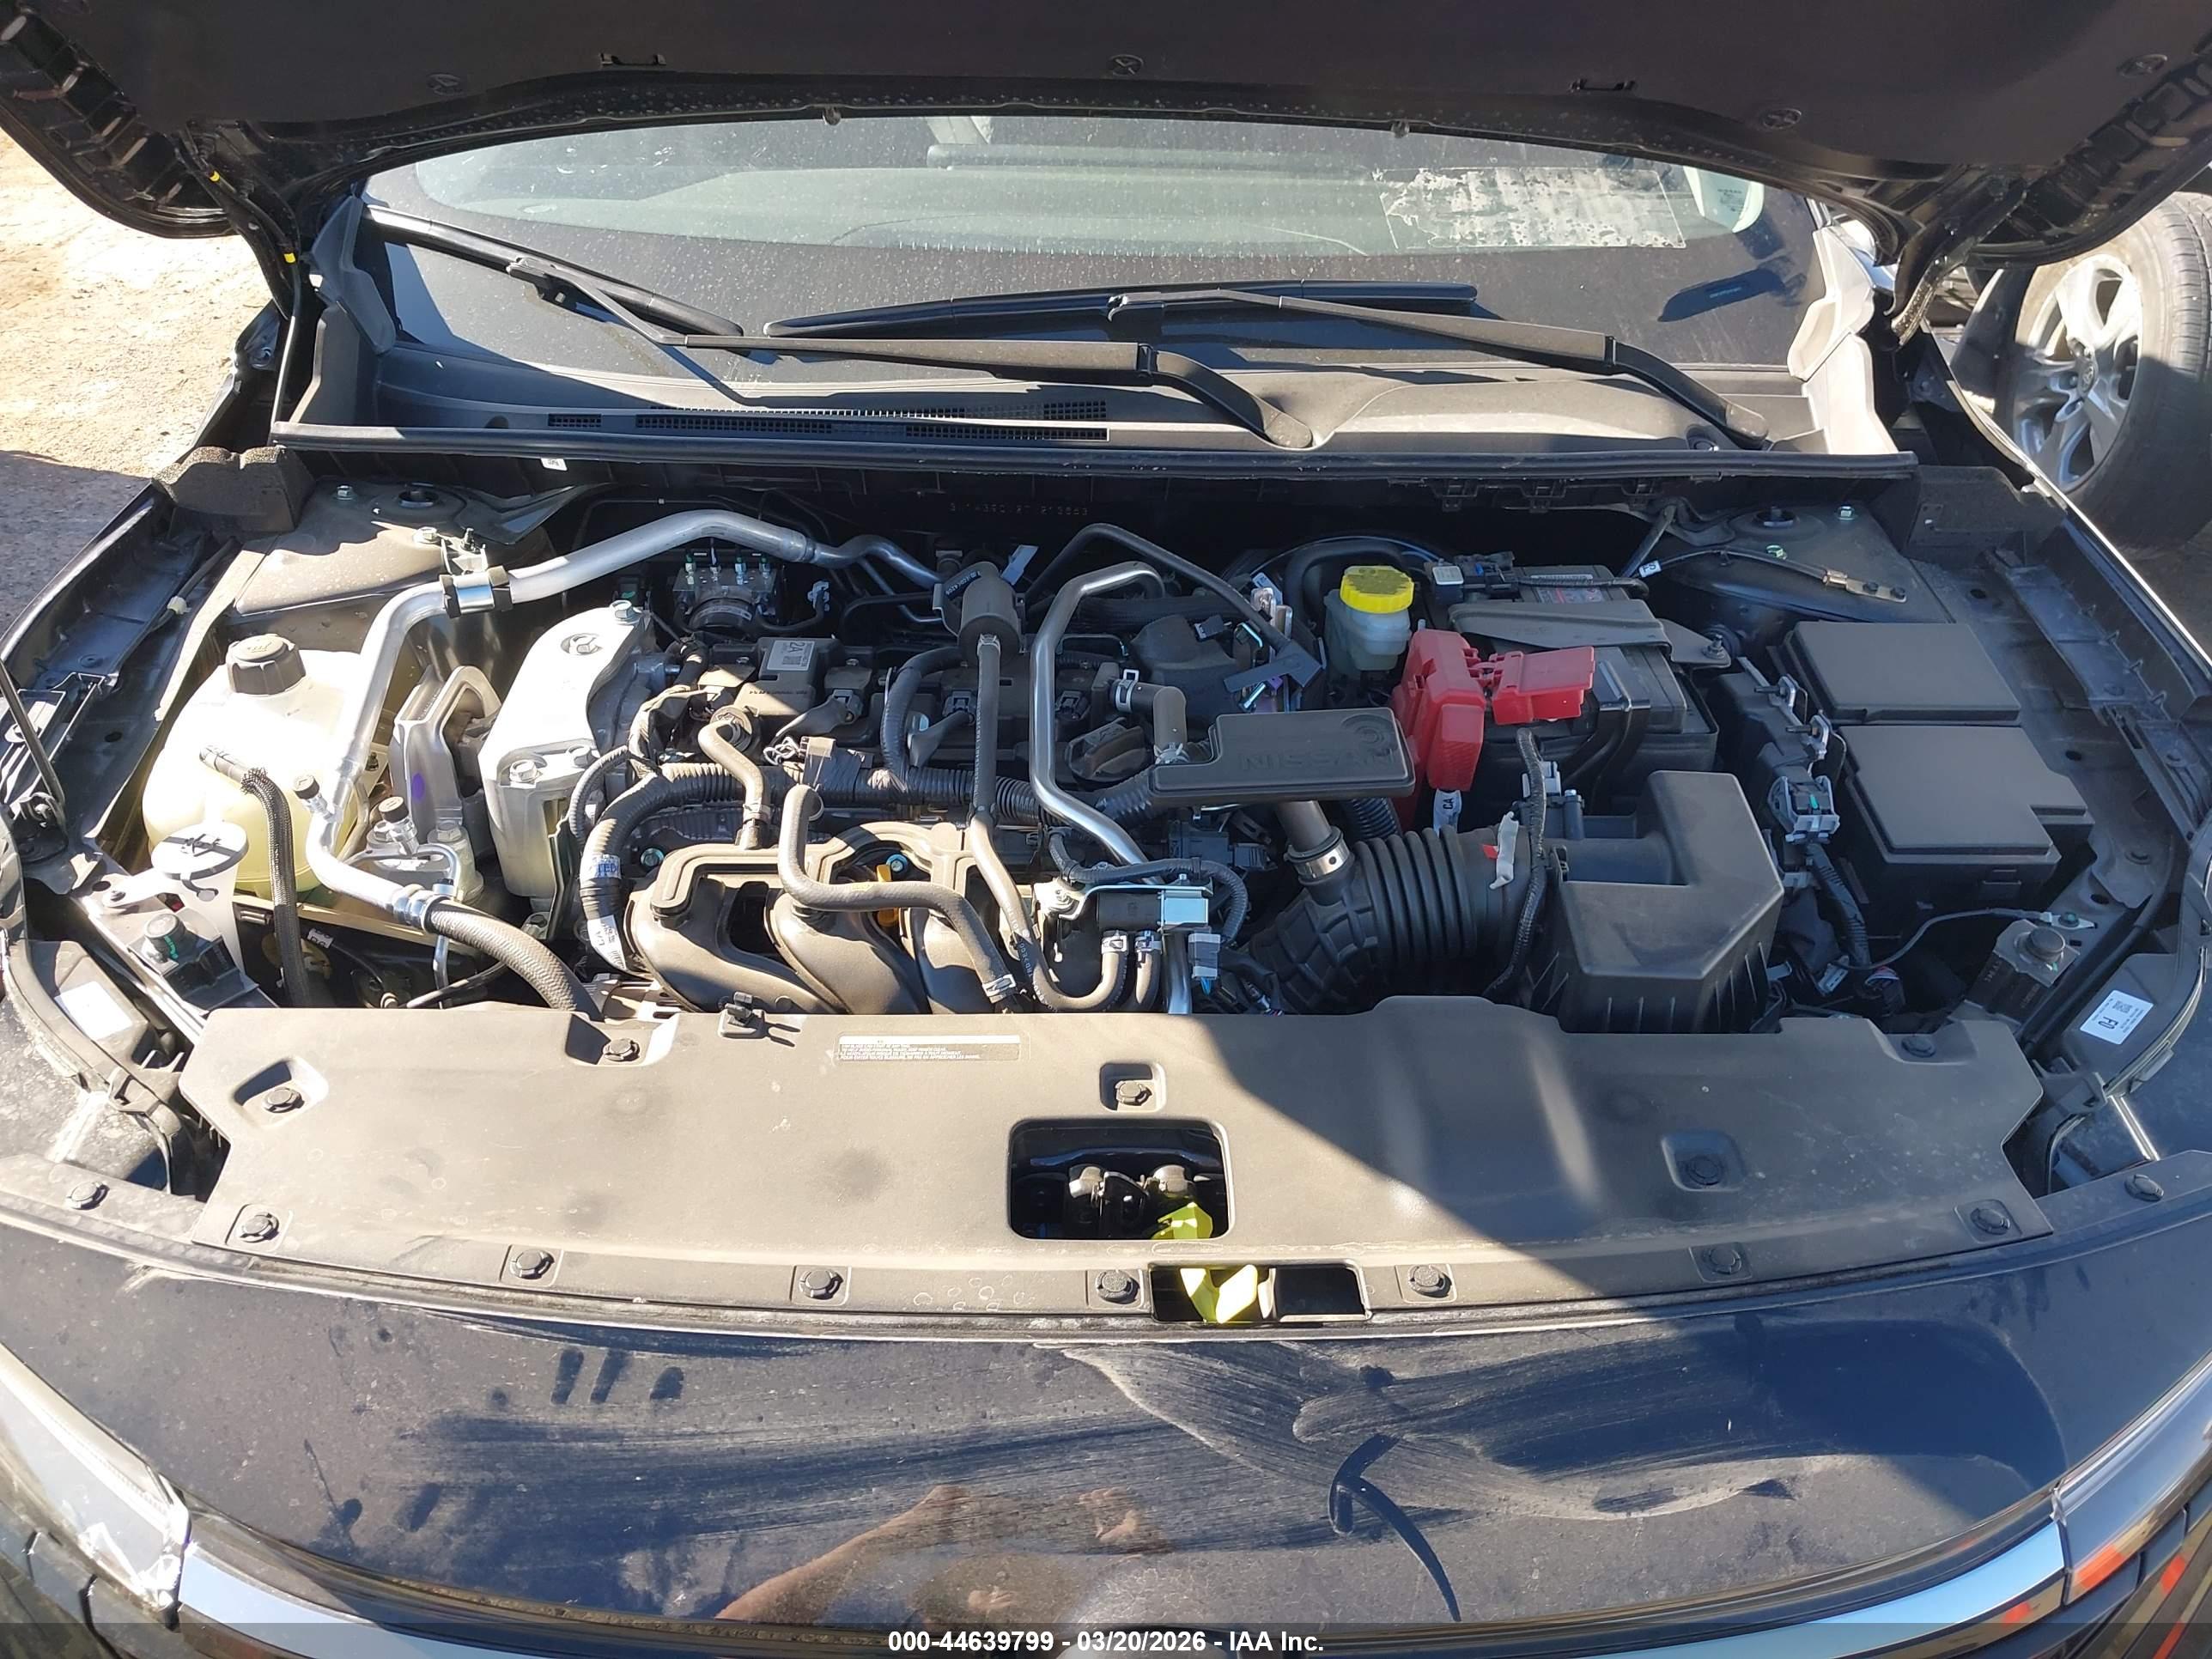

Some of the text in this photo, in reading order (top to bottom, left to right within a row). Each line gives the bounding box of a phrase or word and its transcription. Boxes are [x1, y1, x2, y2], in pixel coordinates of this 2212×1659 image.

[789, 641, 805, 653] 2A
[1240, 748, 1395, 771] NISSAN
[1442, 798, 1455, 810] CA
